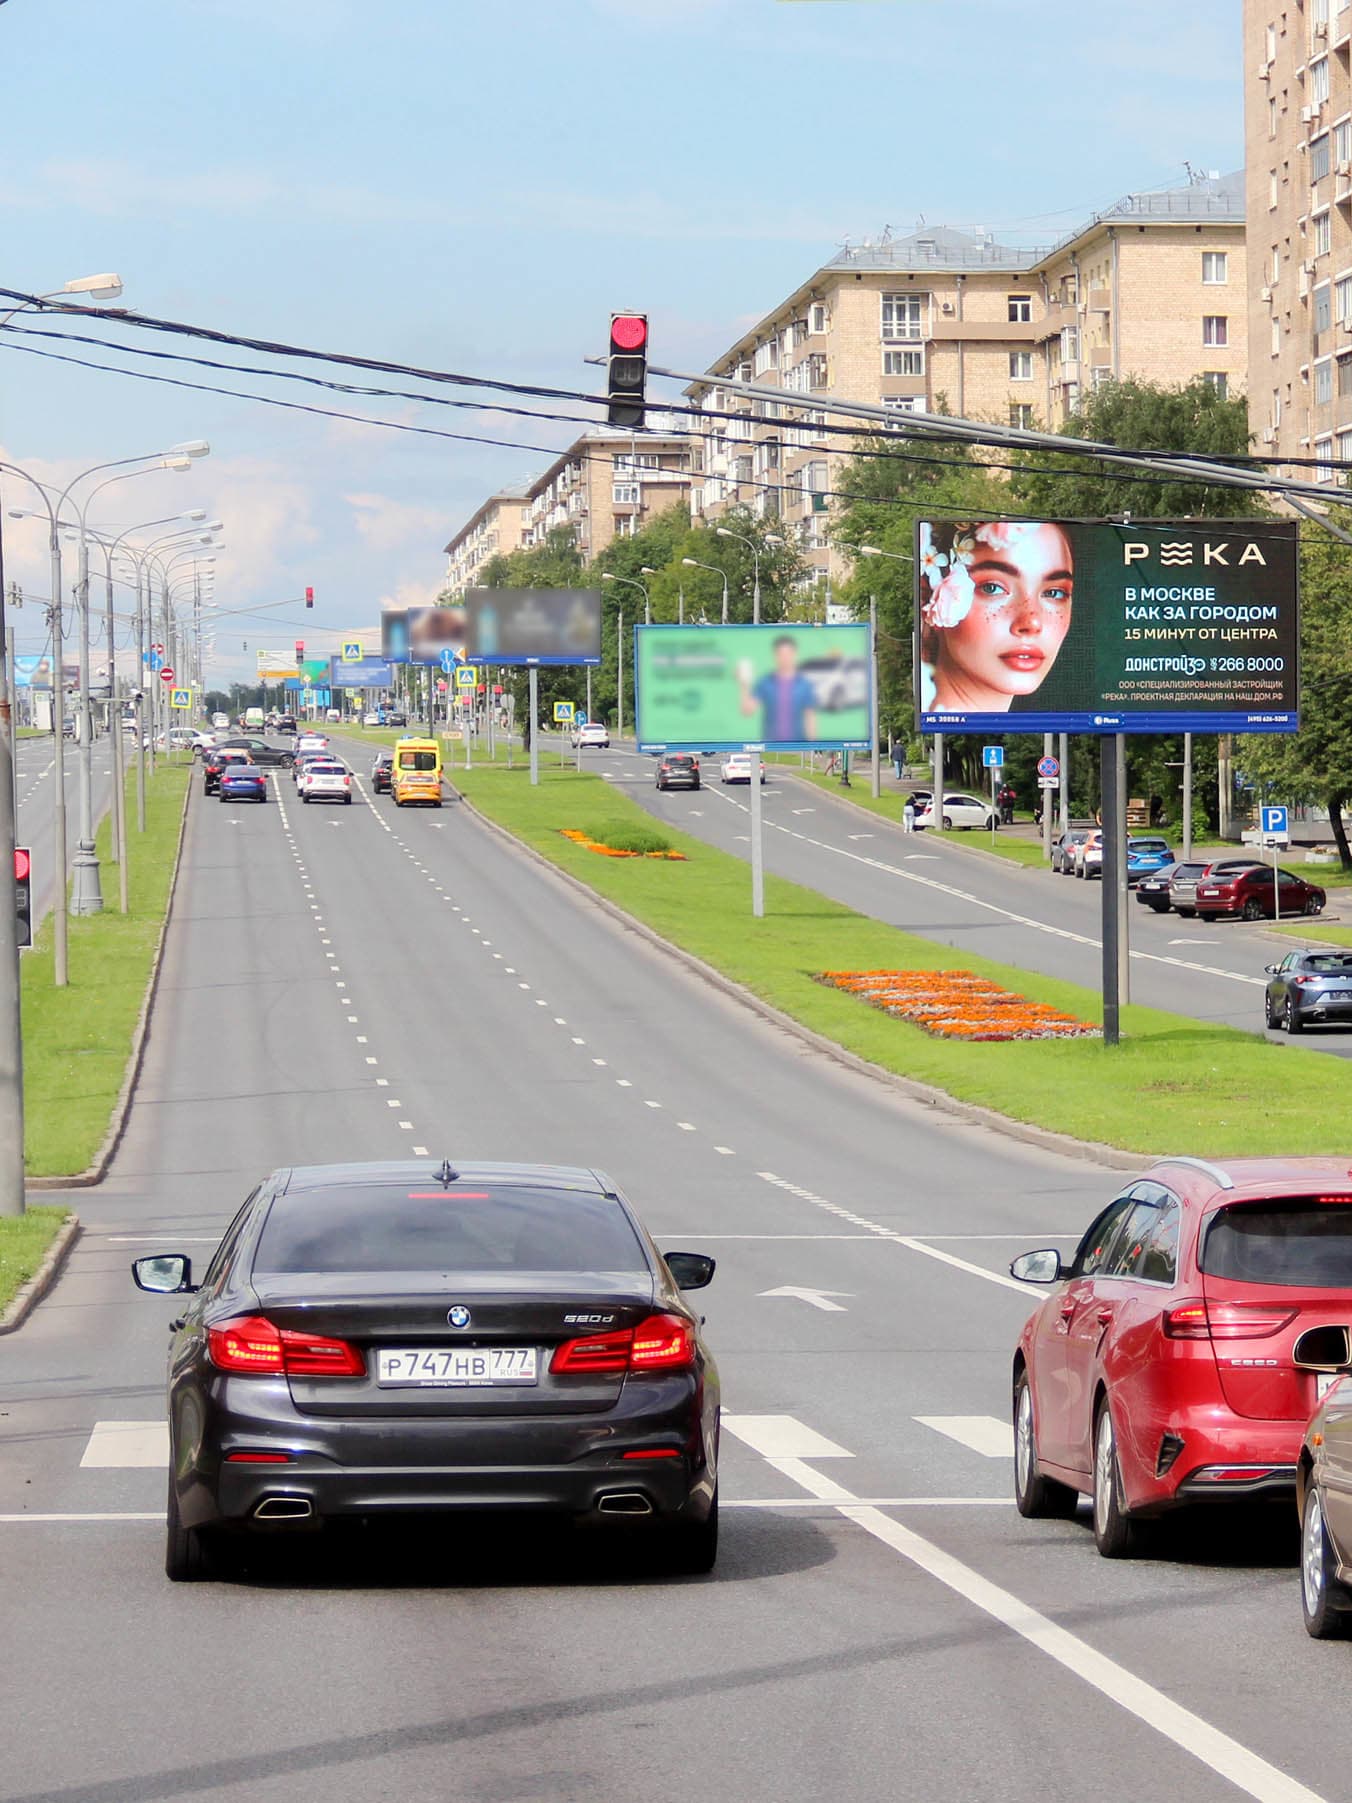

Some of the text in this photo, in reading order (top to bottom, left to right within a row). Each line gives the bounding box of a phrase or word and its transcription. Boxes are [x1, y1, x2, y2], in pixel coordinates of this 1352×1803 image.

[1125, 588, 1215, 601] В МОСКВЕ
[1125, 606, 1277, 623] КАК ЗА ГОРОДОМ
[1125, 628, 1277, 642] 15 МИНУТ ОТ ЦЕНТРА
[1218, 657, 1244, 671] 266
[1247, 657, 1284, 672] 8000
[1118, 680, 1135, 689] ООО
[1233, 679, 1283, 690] ЗАСТРОЙЩИК
[1130, 692, 1174, 701] ПРОЕКТНАЯ
[1174, 692, 1223, 702] ДЕКЛАРАЦИЯ
[1224, 692, 1235, 701] НА
[1269, 810, 1283, 830] P
[492, 1350, 528, 1369] 777
